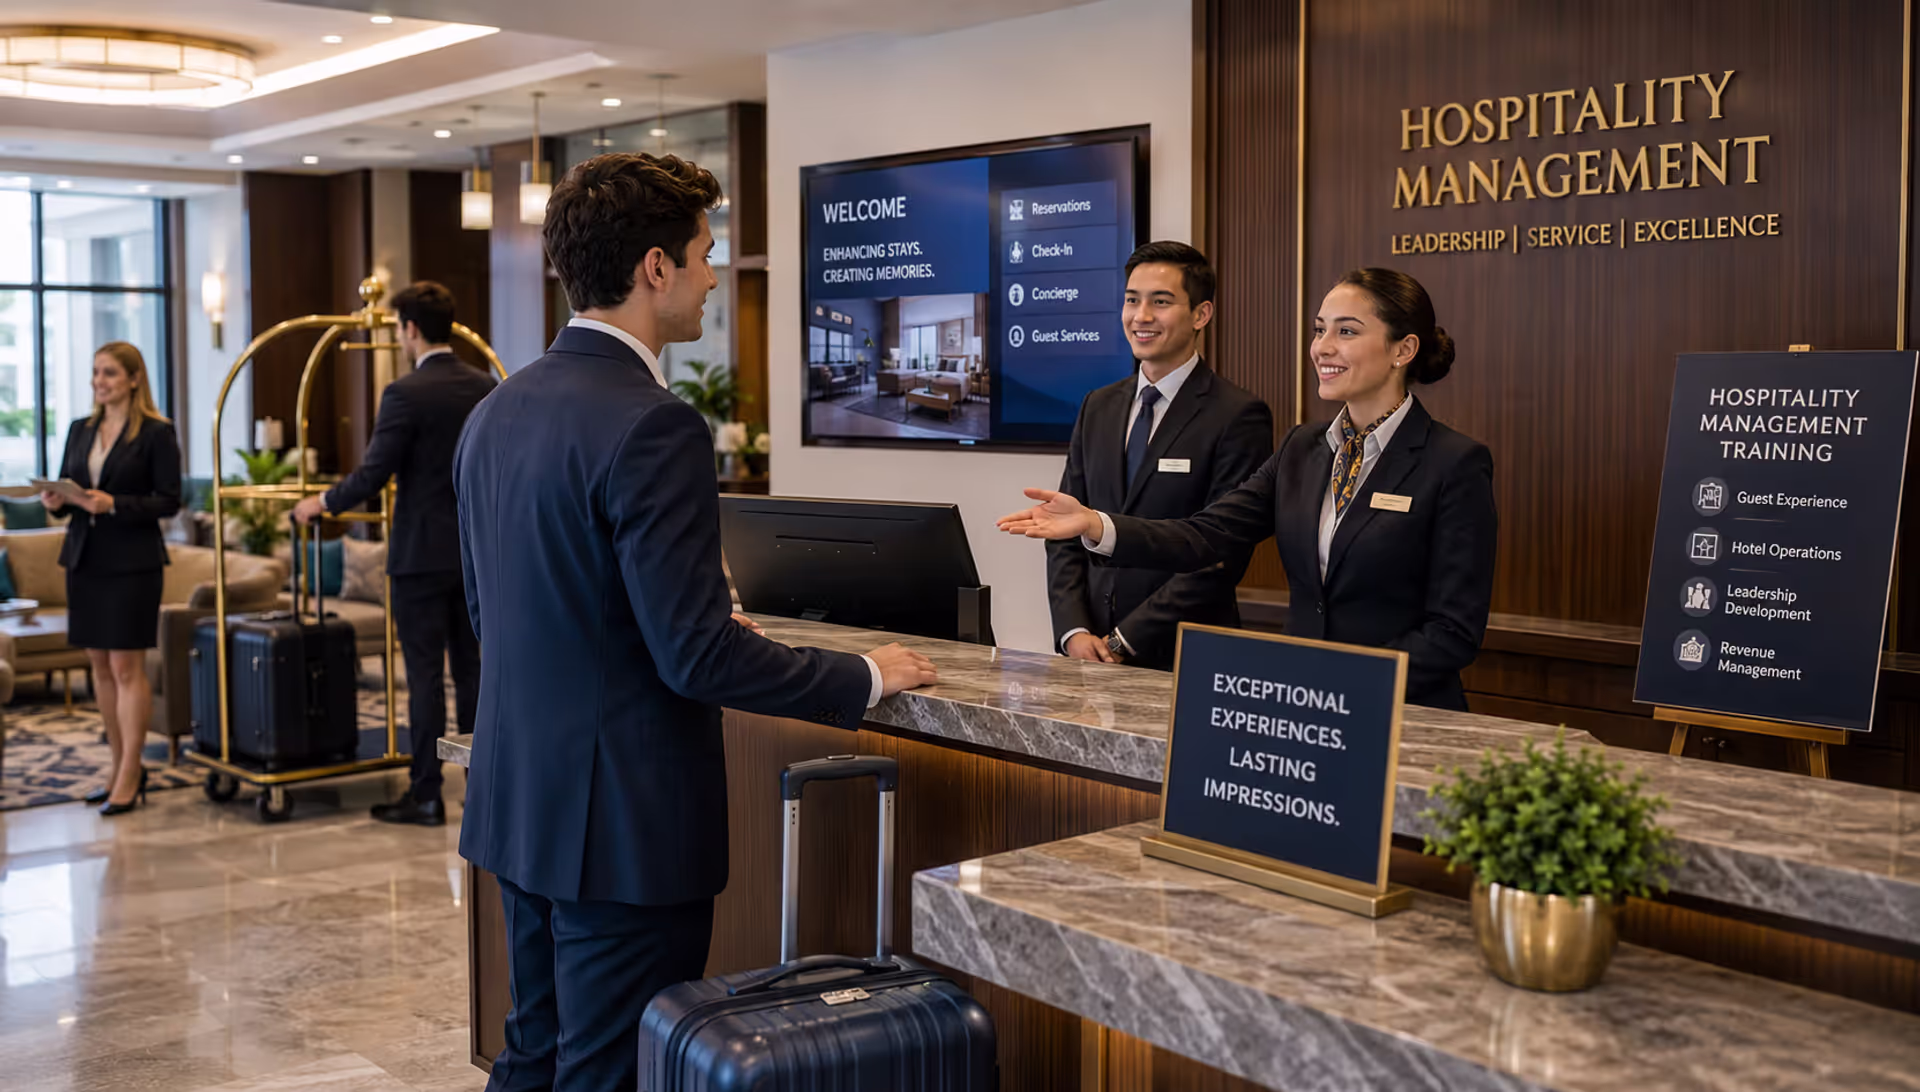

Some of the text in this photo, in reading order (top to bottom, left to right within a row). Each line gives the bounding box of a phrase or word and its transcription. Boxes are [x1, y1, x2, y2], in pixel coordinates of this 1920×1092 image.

[1400, 70, 1735, 151] HOSPITALITY
[1392, 135, 1770, 209] MANAGEMENT
[823, 196, 906, 224] WELCOME
[1032, 199, 1091, 215] Reservations
[1392, 213, 1780, 255] LEADERSHIP SERVICE EXCELLENCE
[823, 241, 923, 262] ENHANCING STAYS.
[1032, 243, 1073, 258] Check-In
[823, 263, 935, 284] CREATING MEMORIES.
[1032, 287, 1079, 302] Concierge
[1032, 329, 1100, 343] Guest Services
[1709, 388, 1860, 408] HOSPITALITY
[1700, 414, 1868, 436] MANAGEMENT
[1720, 440, 1833, 463] TRAINING
[1737, 491, 1848, 510] Guest Experience
[1732, 541, 1842, 562] Hotel Operations
[1727, 584, 1797, 602] Leadership
[1725, 602, 1812, 622] Development
[1720, 641, 1776, 660] Revenue
[1718, 660, 1802, 681] Management
[1213, 673, 1351, 715] EXCEPTIONAL
[1210, 707, 1347, 750] EXPERIENCES.
[1229, 746, 1317, 783] LASTING
[1204, 777, 1340, 826] IMPRESSIONS.
